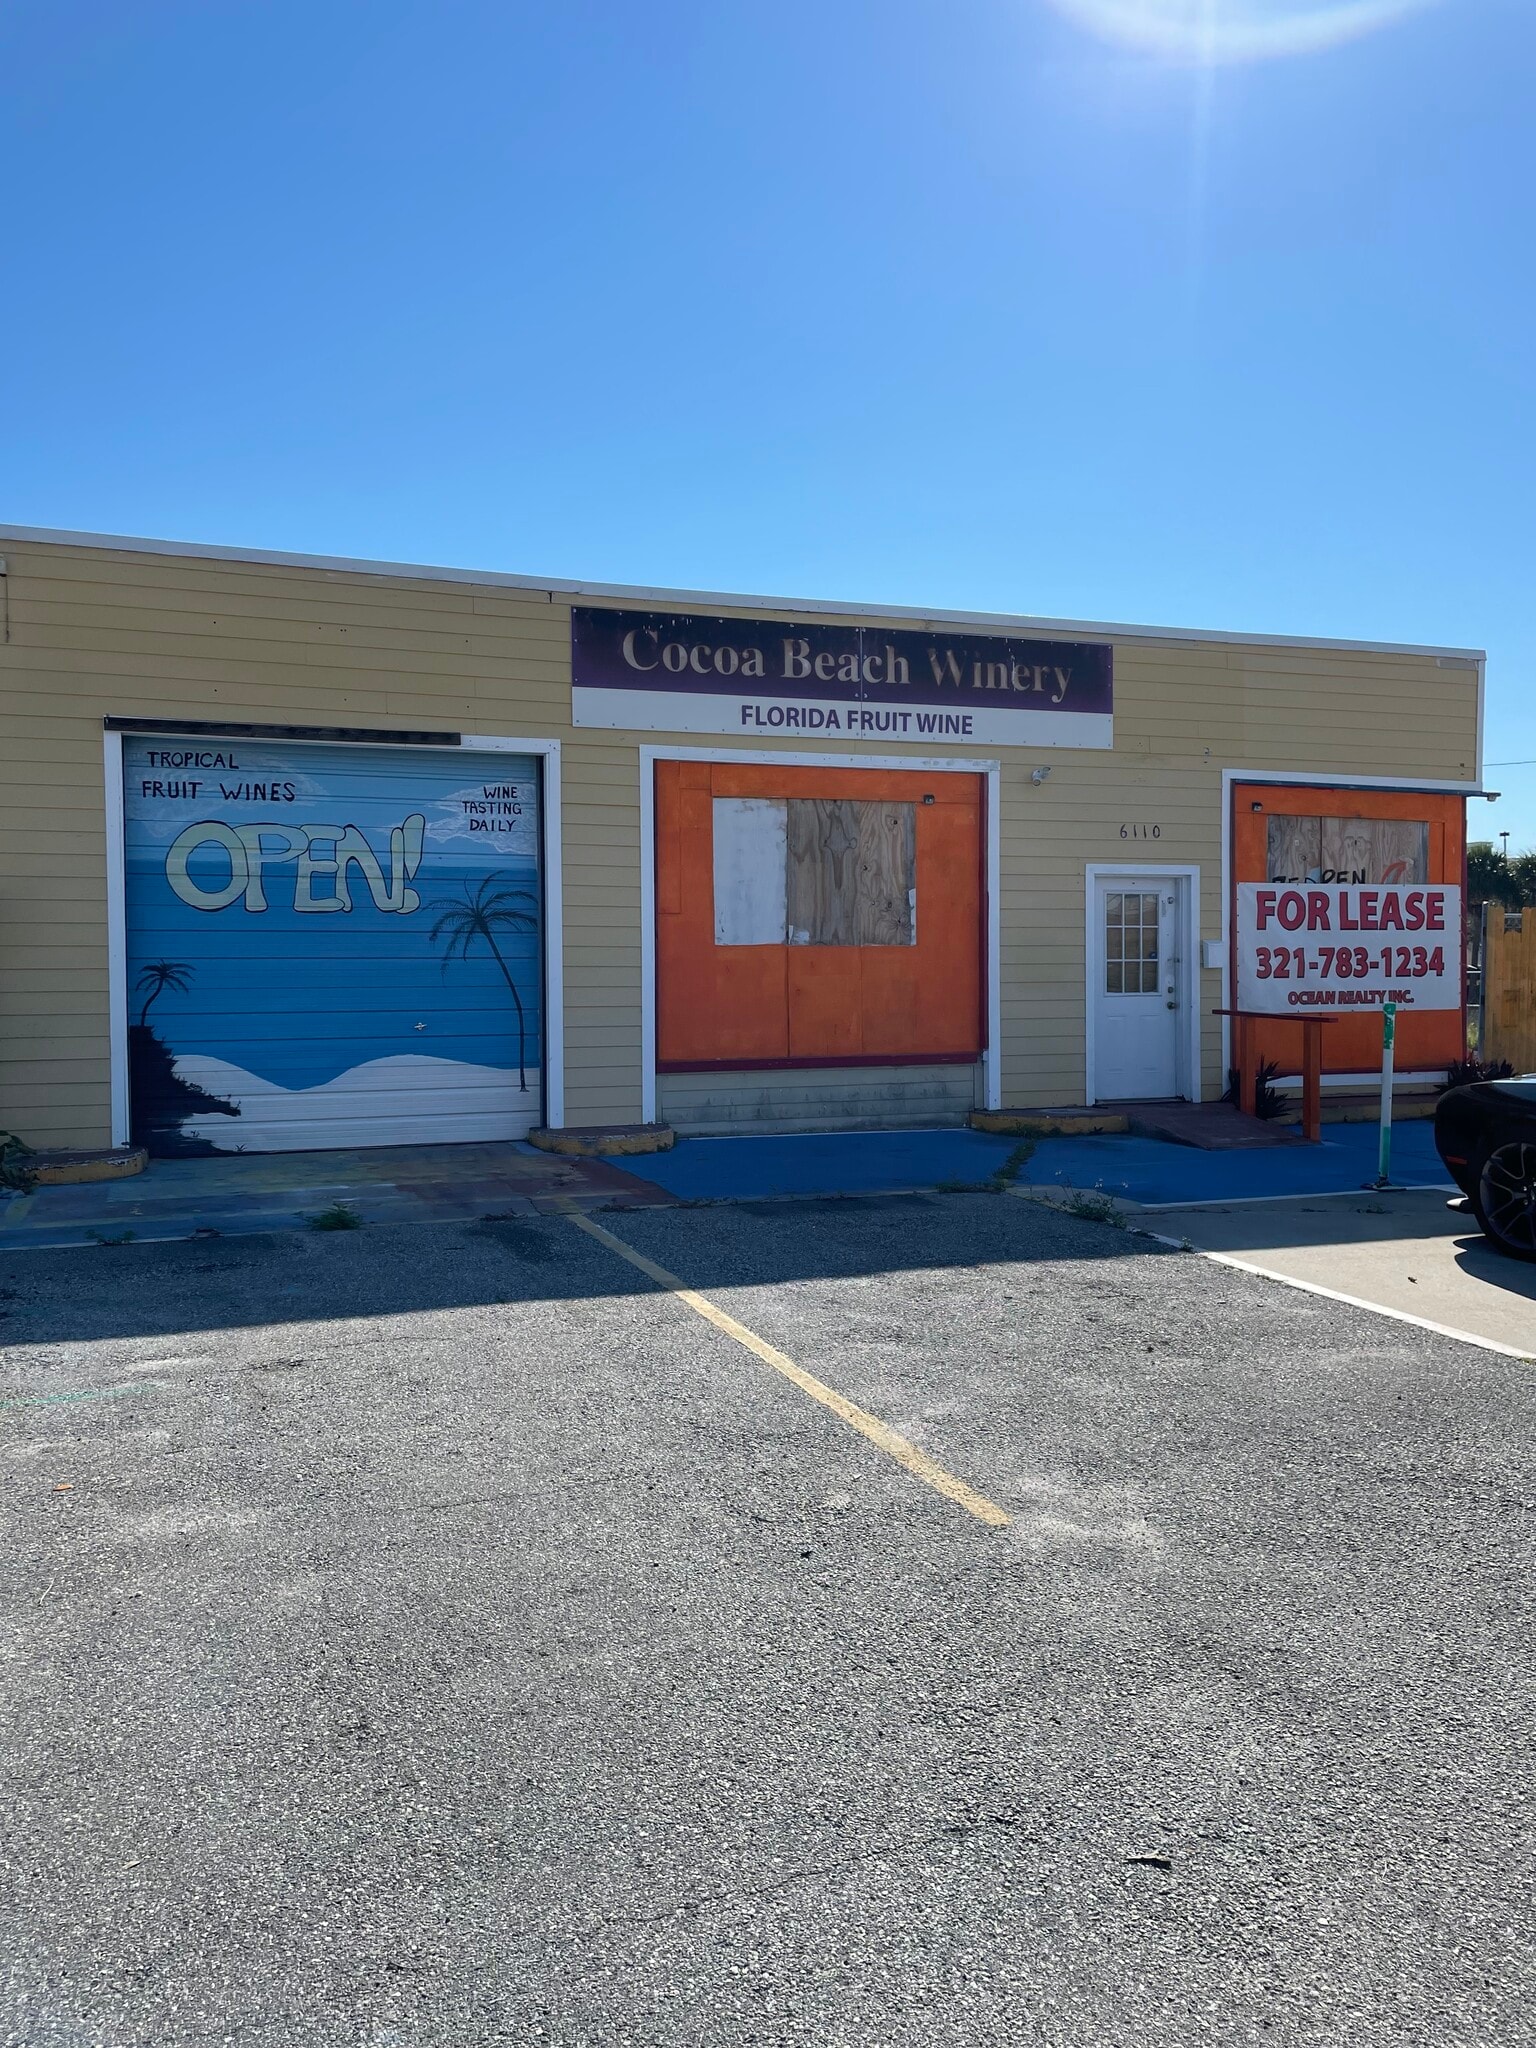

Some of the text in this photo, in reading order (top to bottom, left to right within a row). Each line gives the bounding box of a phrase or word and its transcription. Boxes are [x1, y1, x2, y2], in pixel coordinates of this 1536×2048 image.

[622, 629, 1073, 703] Cocoa Beach Winery
[741, 704, 973, 735] FLORIDA FRUIT WINE
[147, 751, 239, 769] TROPICAL
[142, 780, 295, 802] FRUIT WINES
[483, 786, 518, 799] WINE
[462, 801, 522, 815] TASTING
[470, 819, 517, 832] DAILY
[1120, 823, 1161, 839] 6110
[165, 813, 426, 914] OPEN!
[1256, 890, 1445, 931] FOR LEASE
[1256, 946, 1445, 979] 321-783-1234
[1288, 989, 1415, 1005] OCEAN REALTY INC.
